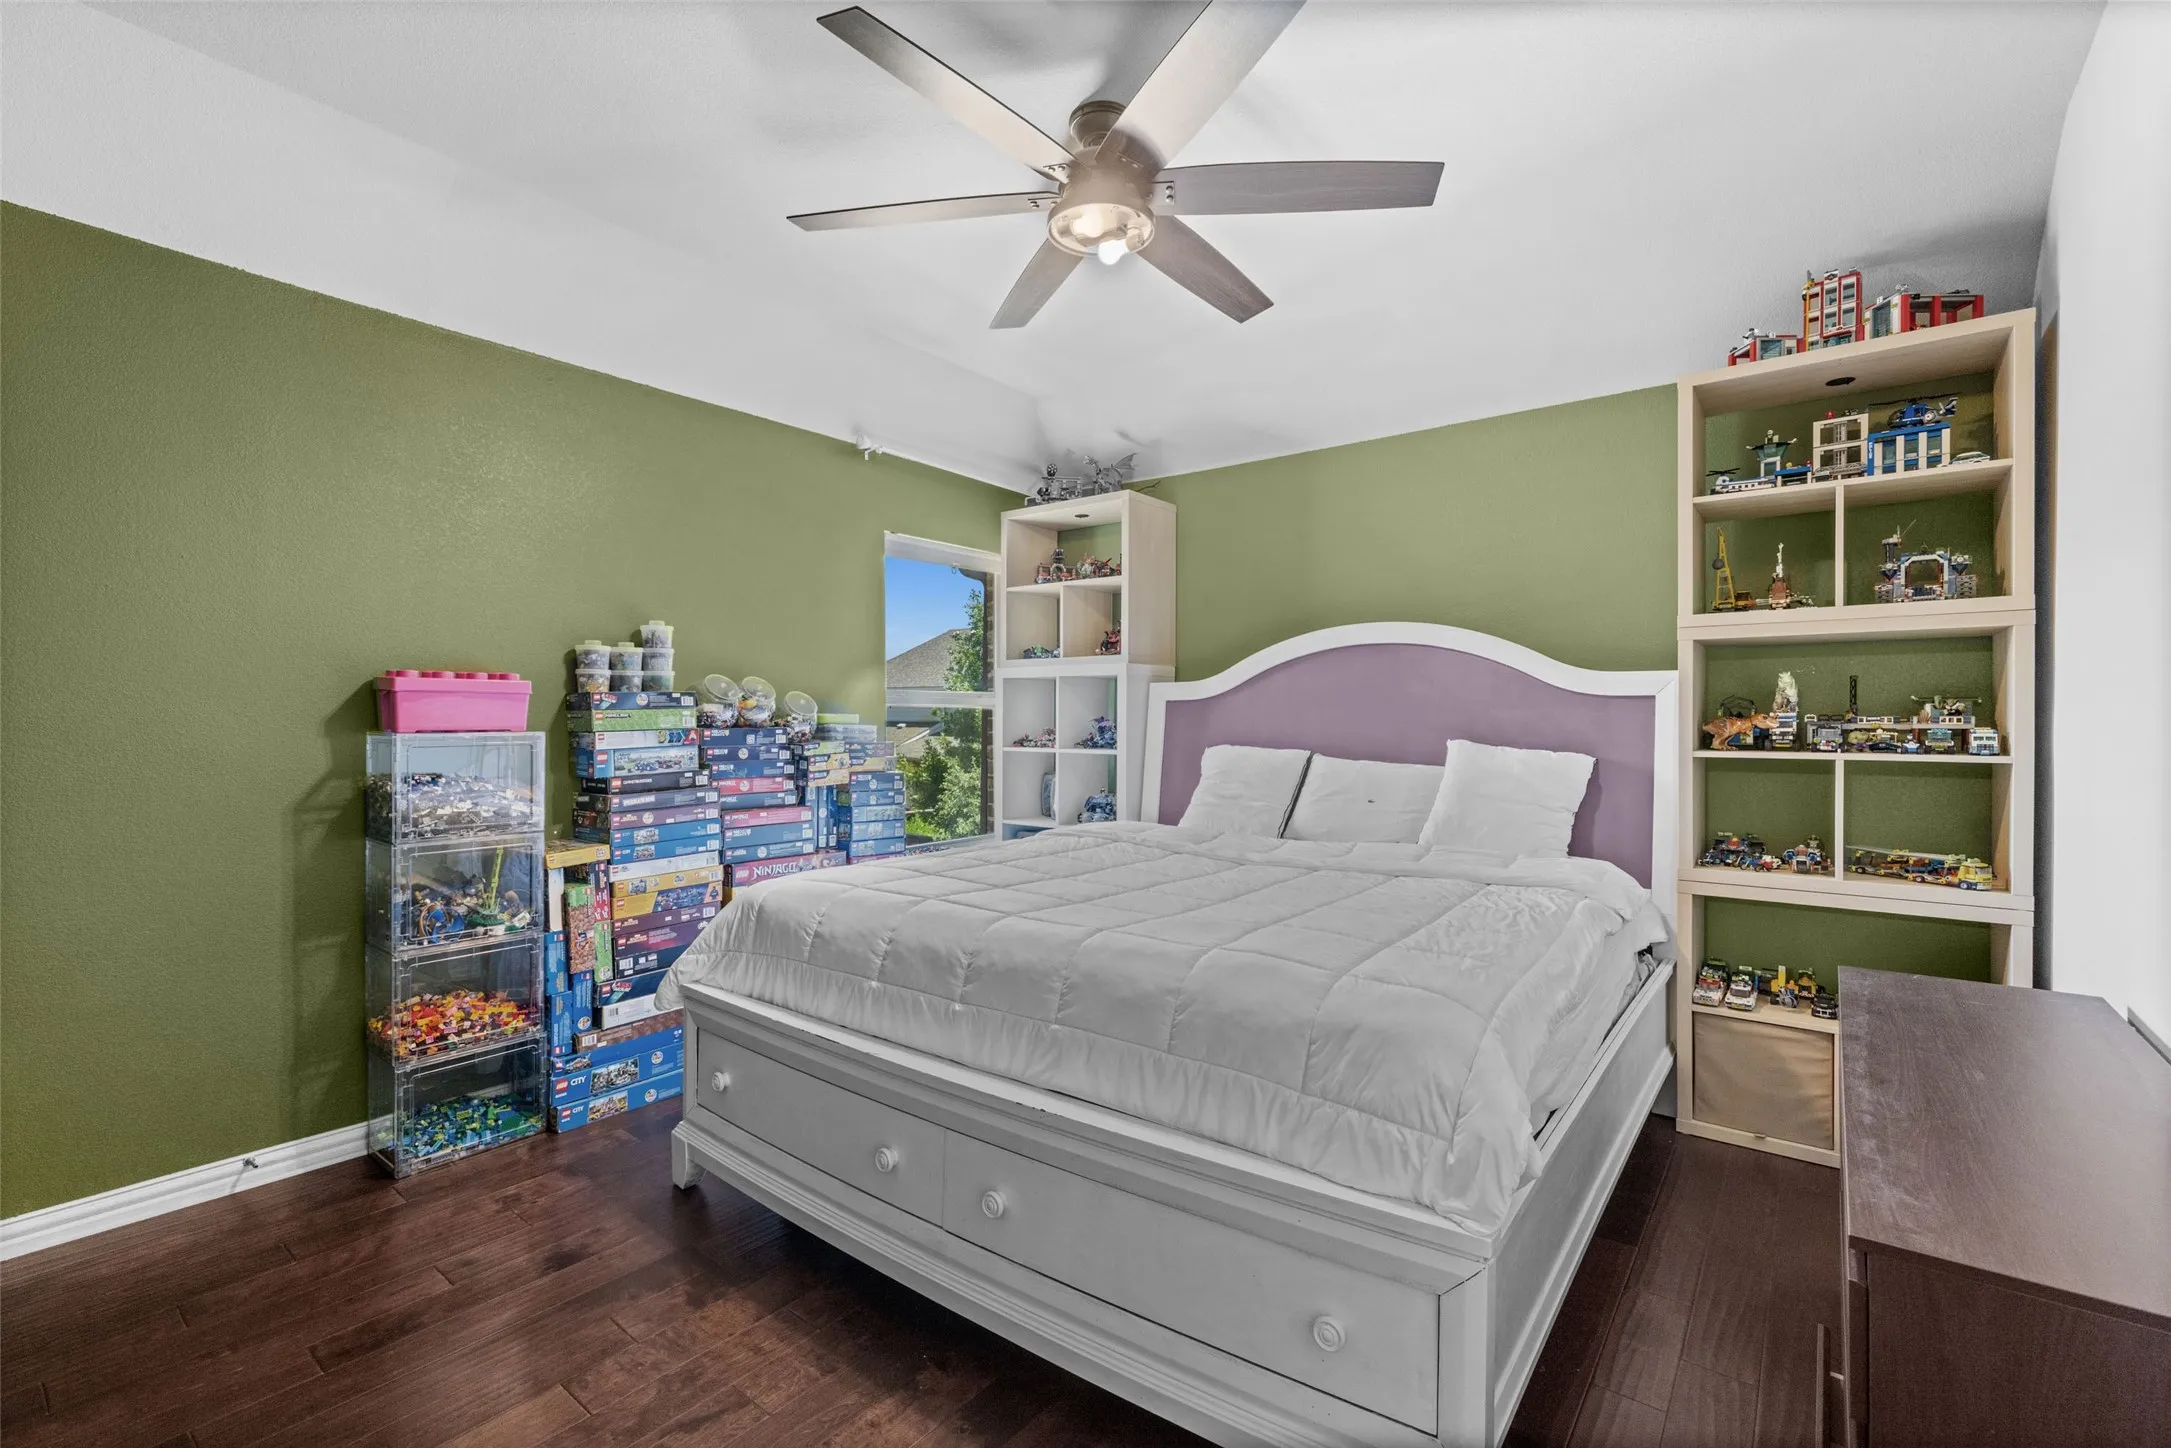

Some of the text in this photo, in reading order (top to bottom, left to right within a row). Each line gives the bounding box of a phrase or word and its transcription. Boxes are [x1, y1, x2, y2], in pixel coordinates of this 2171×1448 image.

[752, 862, 798, 880] NINJAGO
[570, 1075, 587, 1086] CITY
[572, 1105, 585, 1113] CITY
